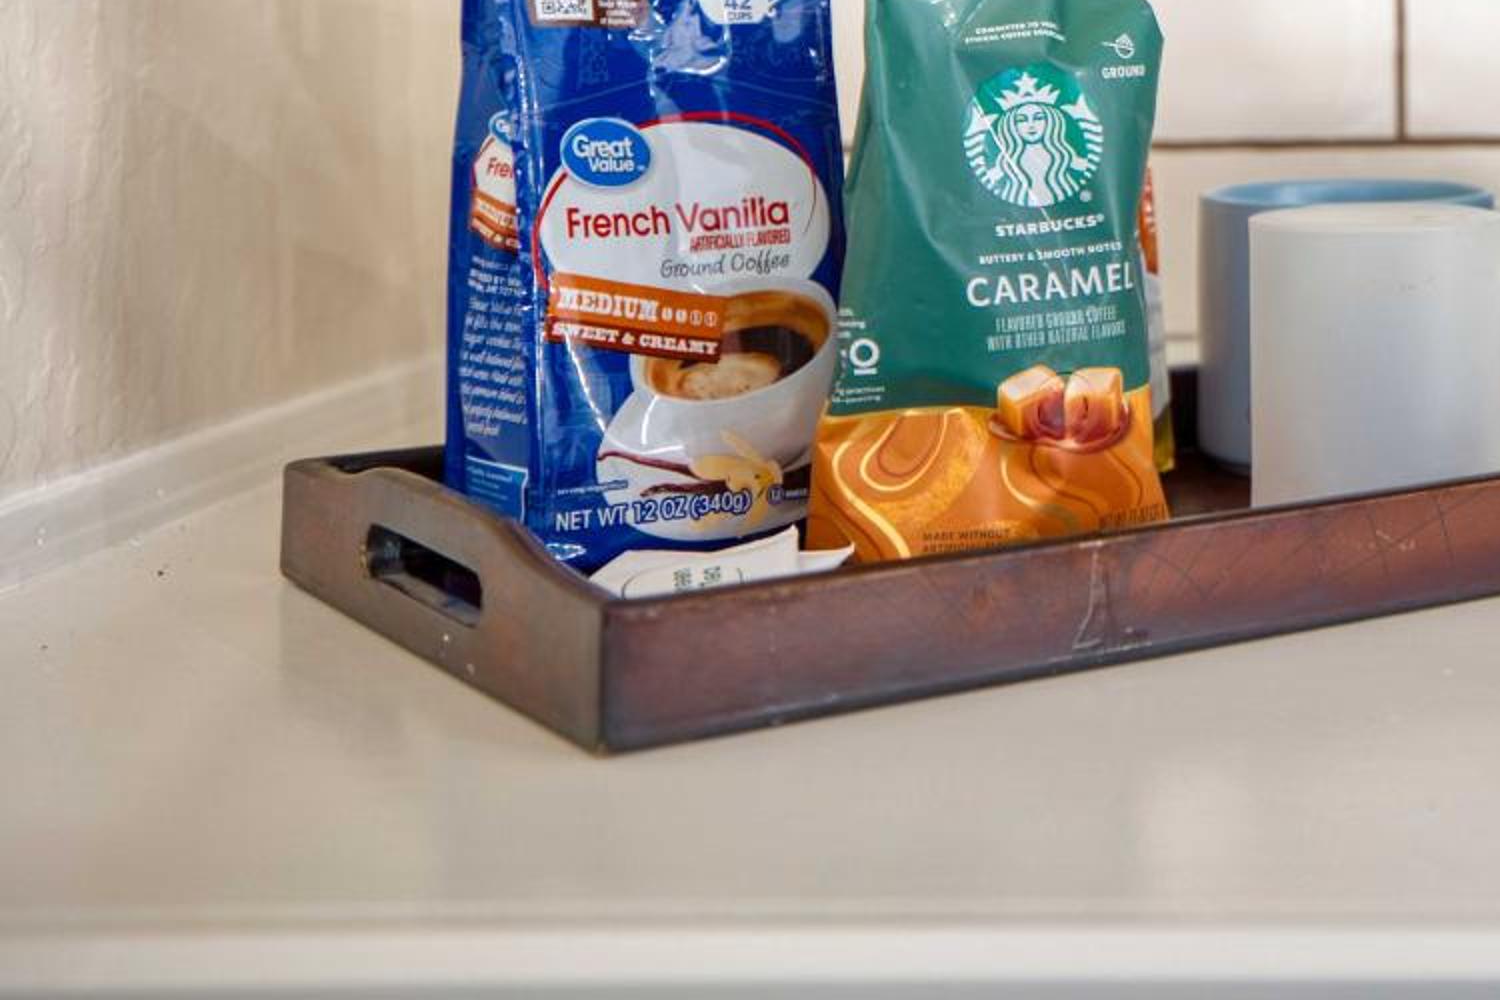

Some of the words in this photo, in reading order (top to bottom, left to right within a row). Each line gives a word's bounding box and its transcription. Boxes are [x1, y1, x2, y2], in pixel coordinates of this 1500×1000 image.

[726, 10, 753, 21] CUPS
[1101, 64, 1146, 79] GROUND
[571, 132, 635, 160] Great
[587, 155, 636, 173] Value
[565, 205, 672, 239] French
[674, 195, 790, 233] Vanilla
[994, 214, 1099, 238] STARBUCKS
[659, 255, 726, 279] Ground
[730, 249, 790, 275] Coffee
[978, 252, 1025, 265] BUTTERY
[1037, 247, 1085, 261] SMOOTH
[1087, 240, 1123, 254] NOTES
[965, 261, 1135, 308] CARAMEL
[556, 286, 660, 323] MEDIUM
[551, 321, 619, 343] SWEET
[621, 331, 636, 346] &
[638, 333, 719, 355] CREAMY
[555, 508, 592, 533] NET
[598, 503, 628, 528] WT
[632, 499, 657, 524] 12
[660, 498, 687, 520] OZ
[690, 489, 752, 519] (340g)
